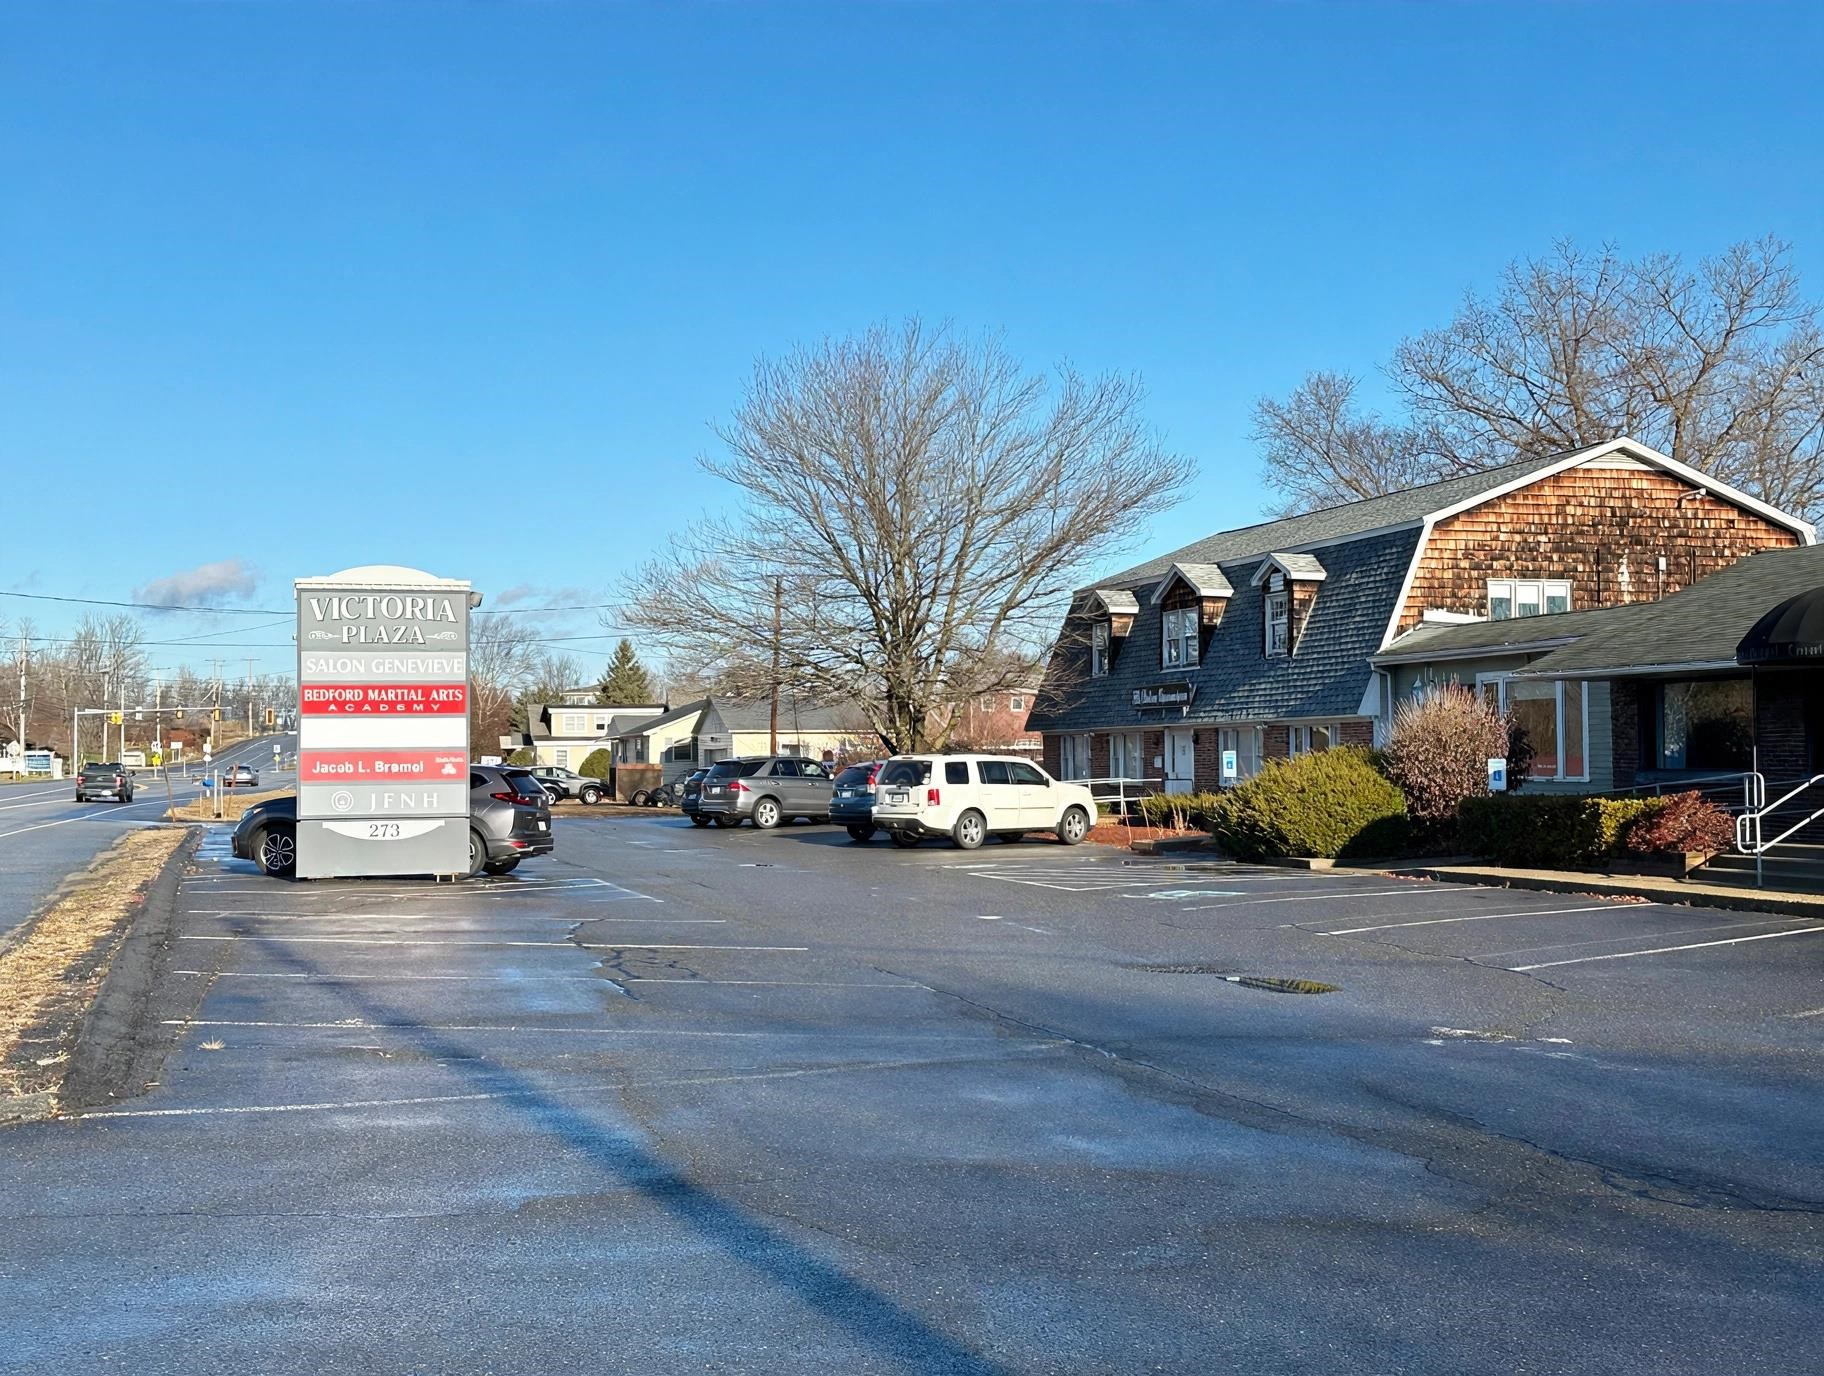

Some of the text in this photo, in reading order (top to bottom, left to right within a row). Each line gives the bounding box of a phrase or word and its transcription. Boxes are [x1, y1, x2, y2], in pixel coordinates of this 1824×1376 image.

[309, 596, 458, 622] VICTORIA
[341, 625, 426, 645] PLAZA
[306, 658, 463, 673] SALON GENEVIEVE
[304, 689, 463, 701] BEDFORD MARTIAL ARTS
[312, 761, 354, 774] Jacob
[358, 761, 370, 773] L.
[369, 824, 400, 838] 273
